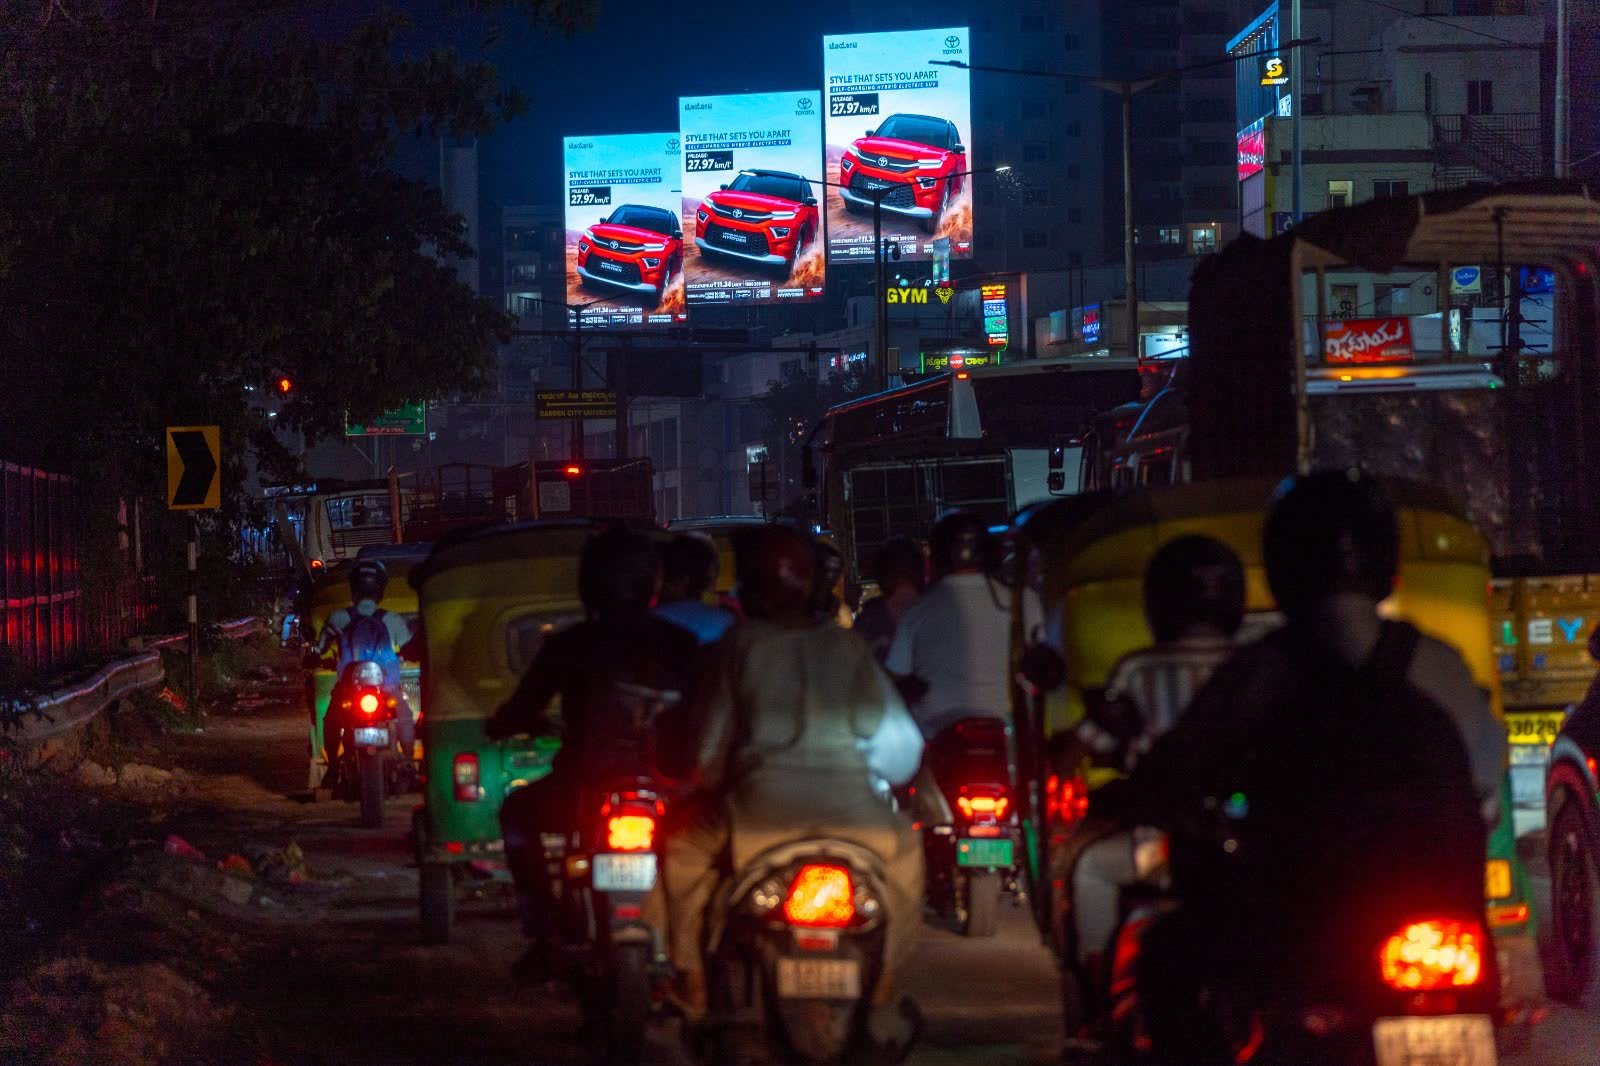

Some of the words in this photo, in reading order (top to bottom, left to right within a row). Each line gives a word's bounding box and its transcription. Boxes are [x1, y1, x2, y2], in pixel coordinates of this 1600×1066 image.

[829, 75, 853, 84] STYLE
[854, 74, 874, 83] THAT
[875, 73, 893, 82] SETS
[894, 72, 912, 81] YOU
[913, 70, 938, 80] APART
[832, 85, 876, 93] SELF-CHARGING
[832, 102, 859, 115] 27.97
[685, 134, 708, 142] STYLE
[709, 132, 728, 141] THAT
[729, 131, 748, 140] SETS
[748, 131, 765, 139] YOU
[767, 129, 791, 138] APART
[687, 159, 714, 170] 27.97
[569, 171, 589, 179] STYLE
[590, 170, 607, 178] THAT
[608, 169, 623, 177] SETS
[640, 168, 661, 176] APART
[570, 194, 595, 204] 27.97
[887, 287, 928, 304] GYM
